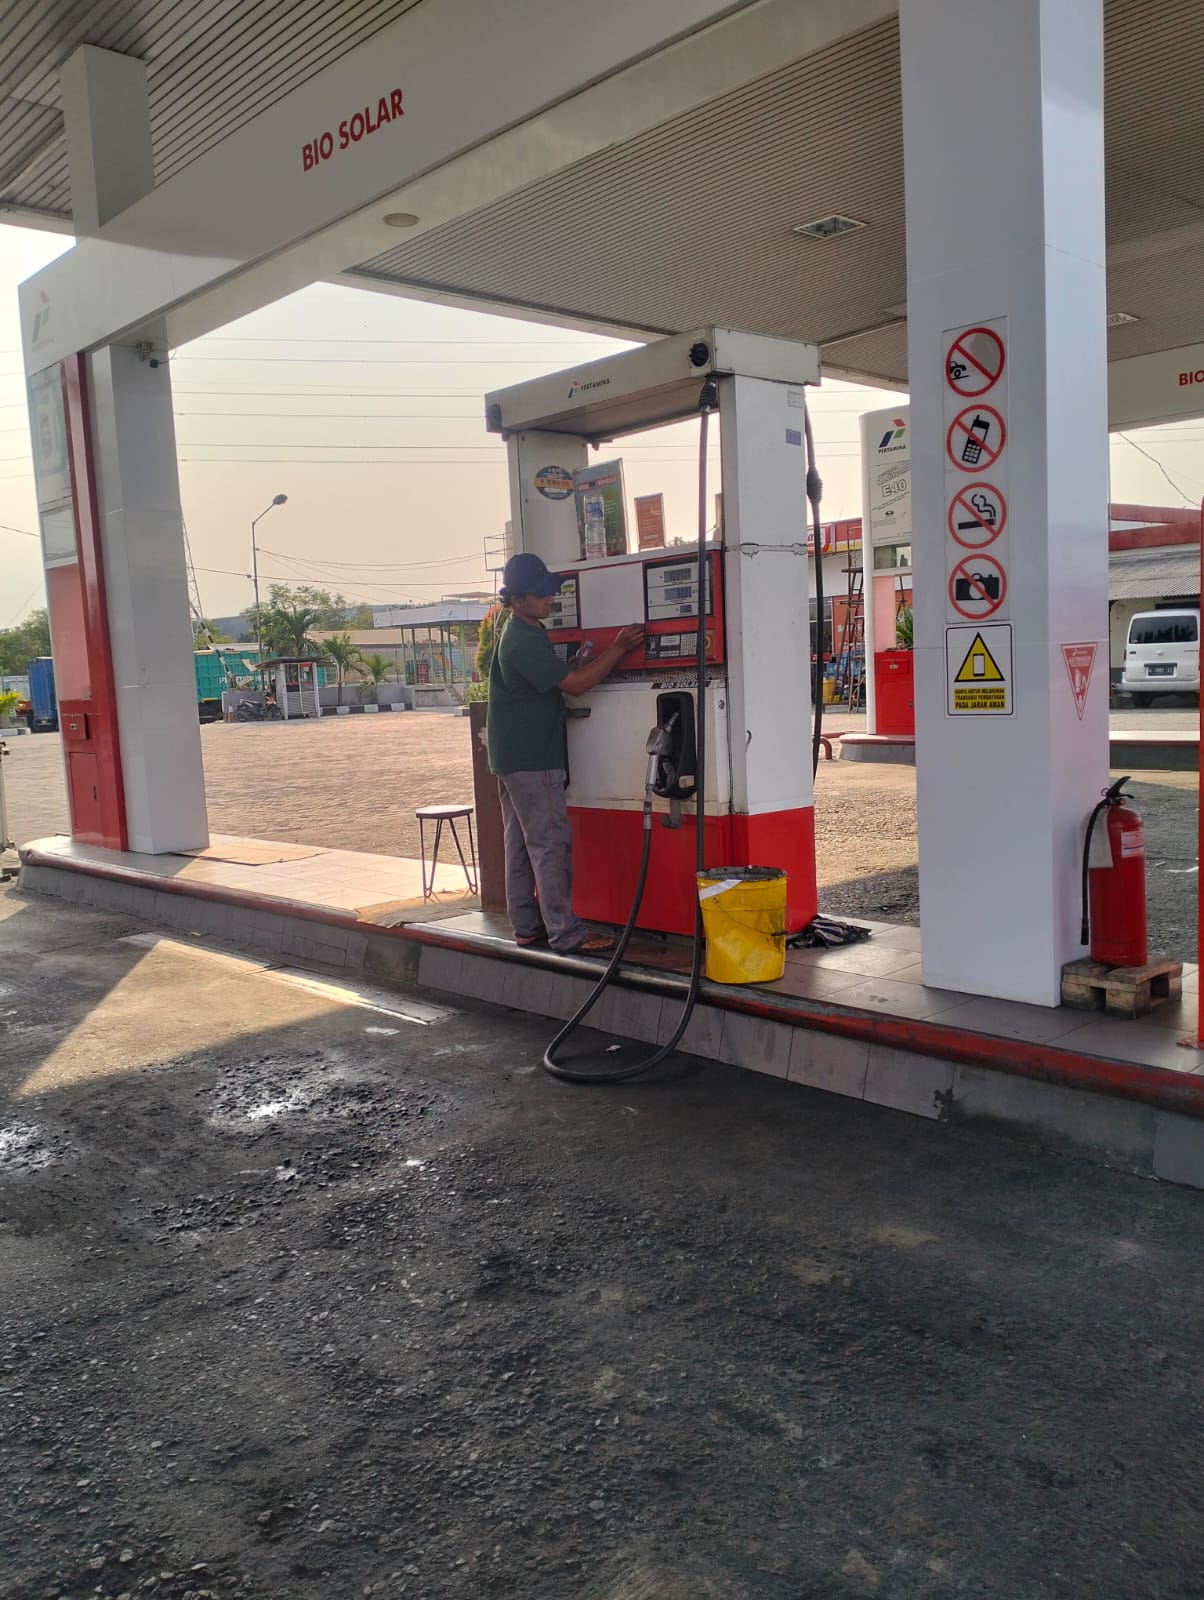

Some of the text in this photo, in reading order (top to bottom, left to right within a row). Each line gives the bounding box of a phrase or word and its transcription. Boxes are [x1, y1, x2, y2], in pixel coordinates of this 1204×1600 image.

[302, 88, 405, 172] BIO SOLAR
[1178, 370, 1204, 386] BIO
[878, 444, 907, 454] PERTAMINA
[955, 701, 969, 709] PADA
[989, 700, 1005, 708] AMAN
